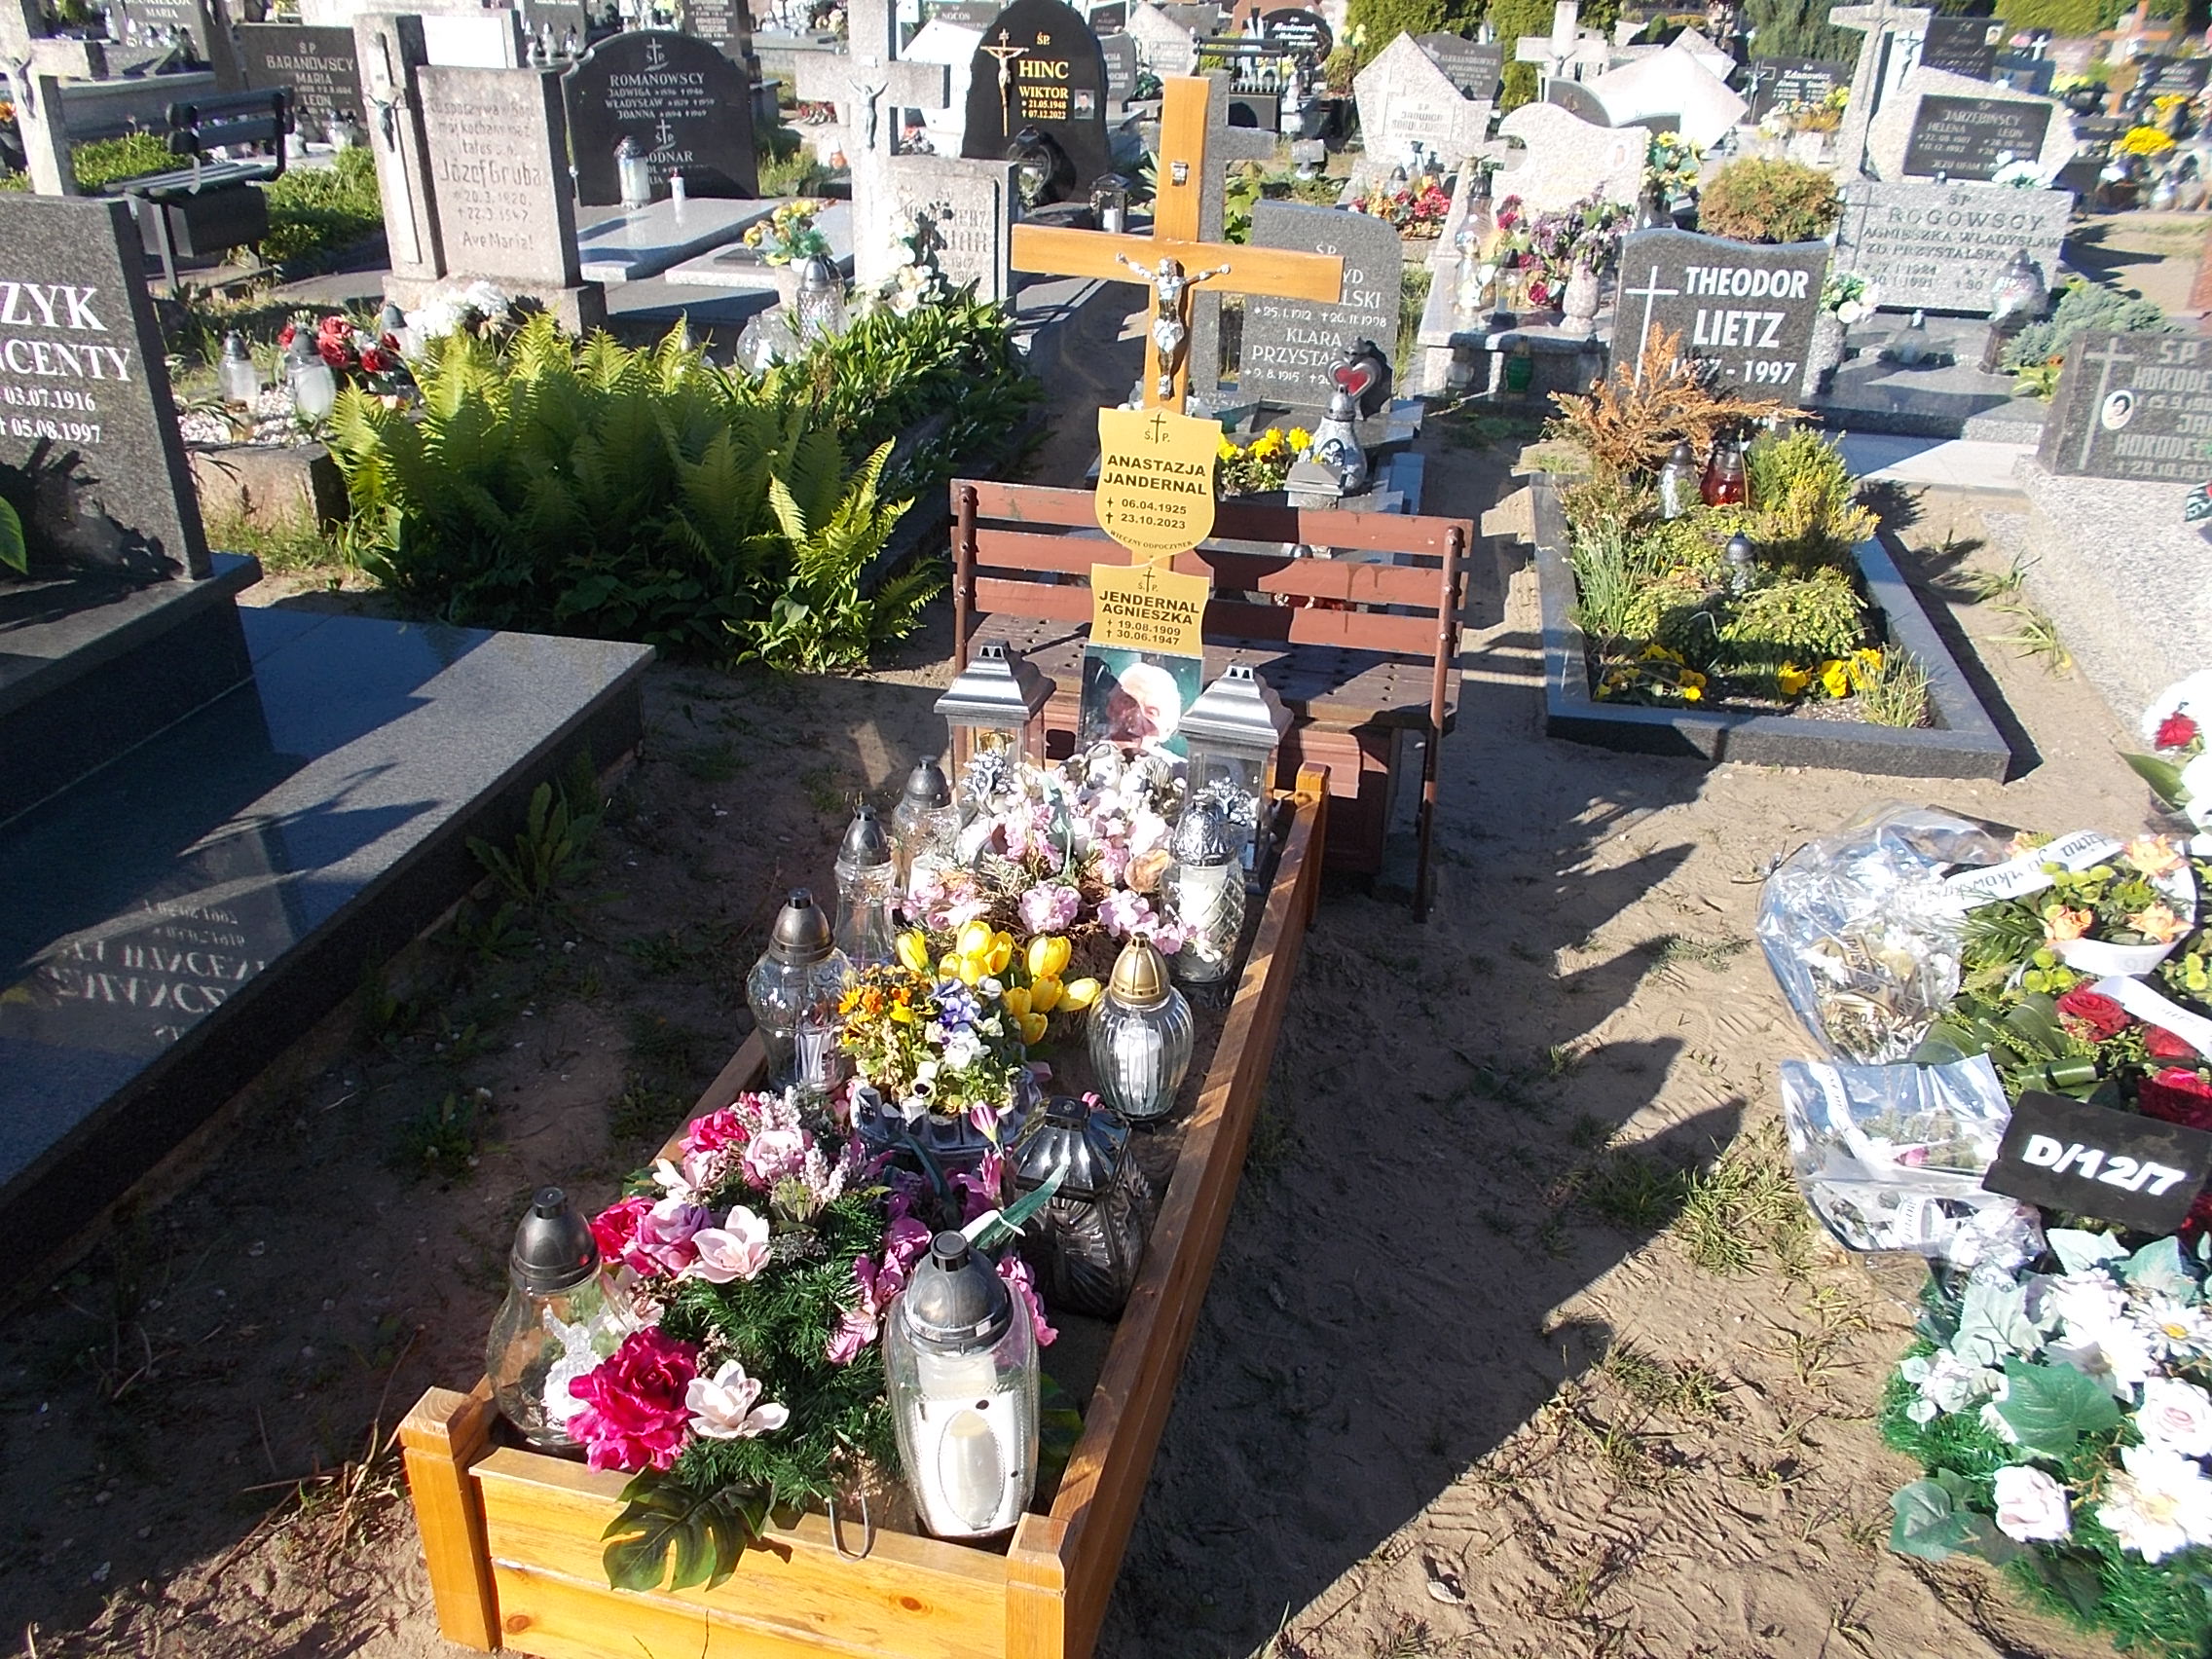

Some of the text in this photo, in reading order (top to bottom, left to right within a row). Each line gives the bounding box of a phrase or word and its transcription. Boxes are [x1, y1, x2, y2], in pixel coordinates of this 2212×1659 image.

[266, 55, 354, 72] BARANOWSCY
[1018, 59, 1070, 79] HINC
[295, 73, 333, 85] MARIA
[608, 73, 705, 87] ROMANOWSCY
[303, 94, 332, 107] LEON
[607, 88, 651, 97] JADWIGA
[1019, 86, 1069, 99] WIKTOR
[1028, 100, 1067, 110] 21.05.1948
[616, 110, 656, 120] JOANNA
[1028, 109, 1067, 120] 07.12.2022
[1927, 122, 1966, 133] HELENA
[1998, 128, 2025, 138] LEON
[440, 157, 542, 187] Józef Gruba
[1887, 206, 2045, 232] ROGOWSCY
[462, 231, 486, 247] Ave
[1863, 225, 1953, 242] AGNIESZKA
[1685, 266, 1810, 299] THEODOR
[1286, 327, 1343, 347] KLARA
[1692, 309, 1787, 349] LIETZ
[0, 338, 132, 382] CENTY
[1251, 345, 1330, 366] PRZYSTA
[1744, 359, 1798, 385] 1997
[5, 386, 96, 412] 03.07.1916
[12, 418, 100, 444] 05.08.1997
[1107, 455, 1206, 477] ANASTAZJA
[1103, 472, 1207, 496] JANDERNAL
[1121, 498, 1187, 515] 06.04.1925
[1121, 512, 1186, 530] 23.10.2023
[1110, 529, 1141, 546] WIECZNY
[1099, 589, 1200, 614] JENDERNAL
[1102, 603, 1194, 626] AGNIESZKA
[1117, 628, 1180, 645] 30.06.1947
[1118, 619, 1182, 637] 19.08.1909
[2021, 1133, 2187, 1197] D/12/7
